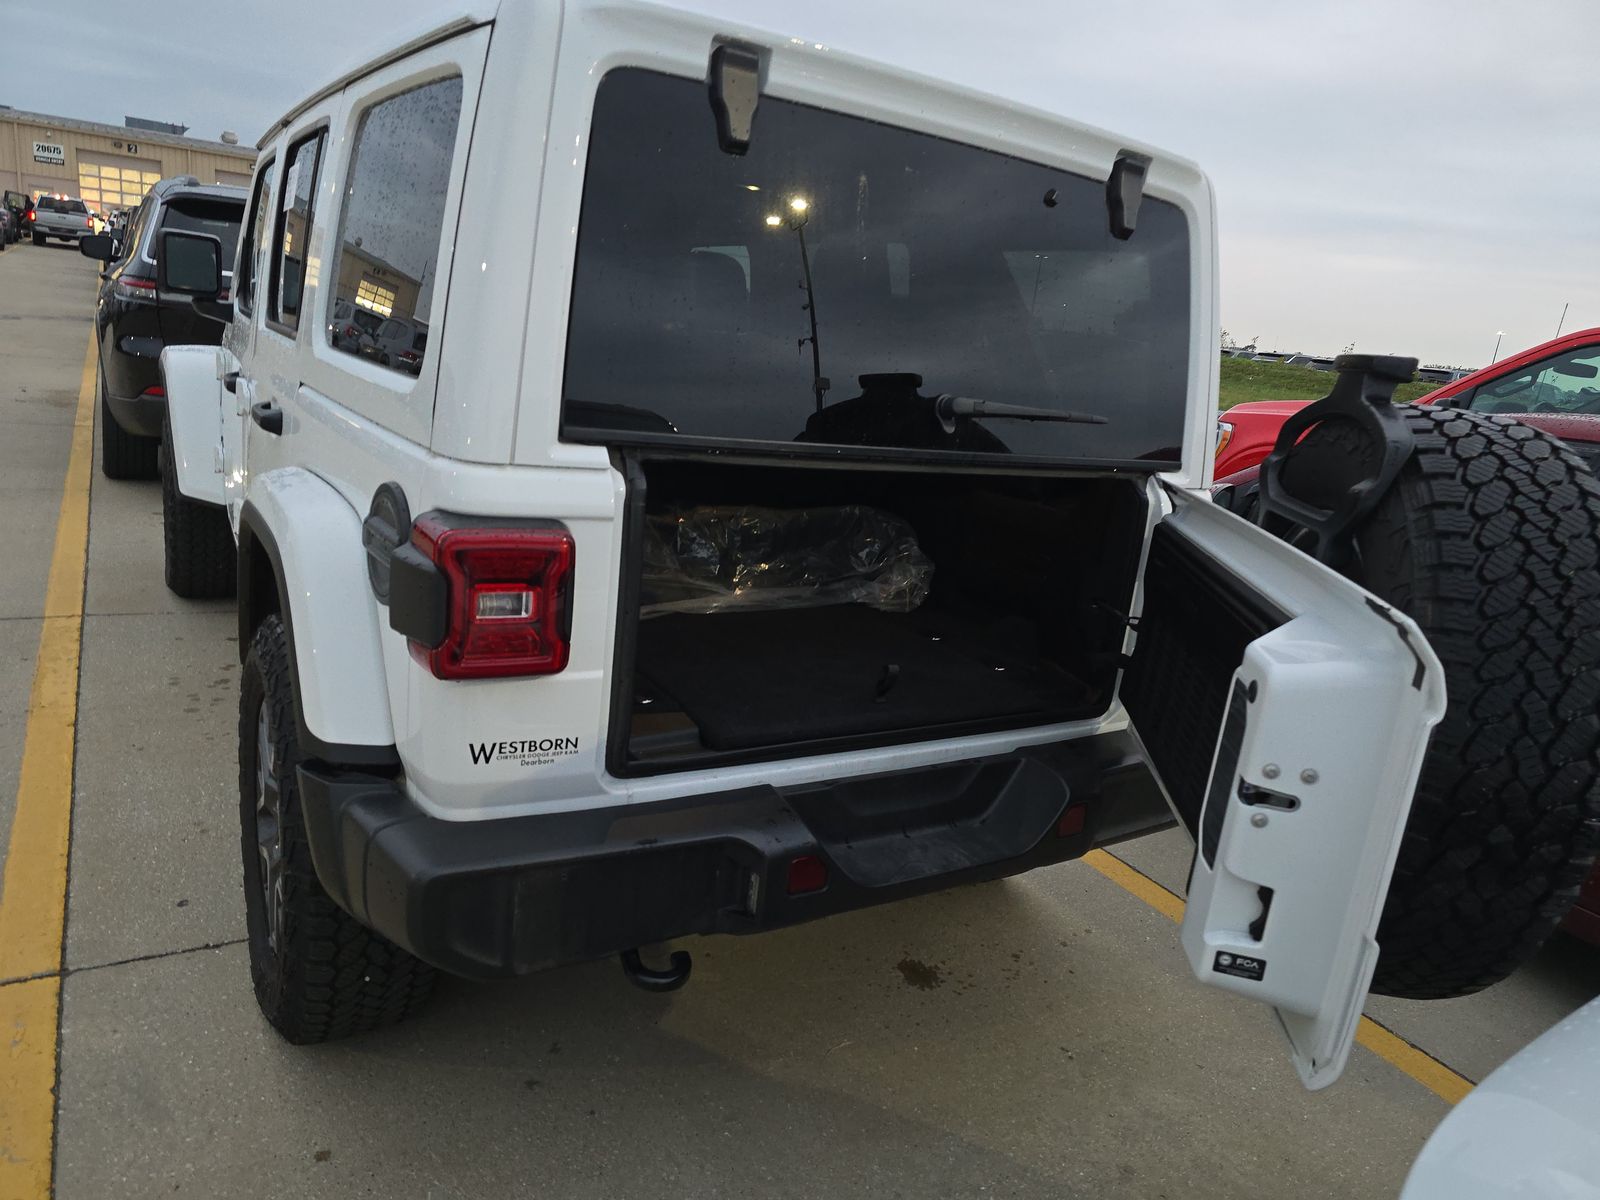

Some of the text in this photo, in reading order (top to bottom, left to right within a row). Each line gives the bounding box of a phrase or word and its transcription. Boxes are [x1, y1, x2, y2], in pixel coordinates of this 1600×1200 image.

[35, 144, 62, 155] 20675
[469, 737, 579, 765] WESTBORN
[496, 753, 526, 761] CHRYSLER
[527, 751, 550, 759] DODGE
[520, 757, 555, 767] Dearborn
[1236, 958, 1259, 969] FCA
